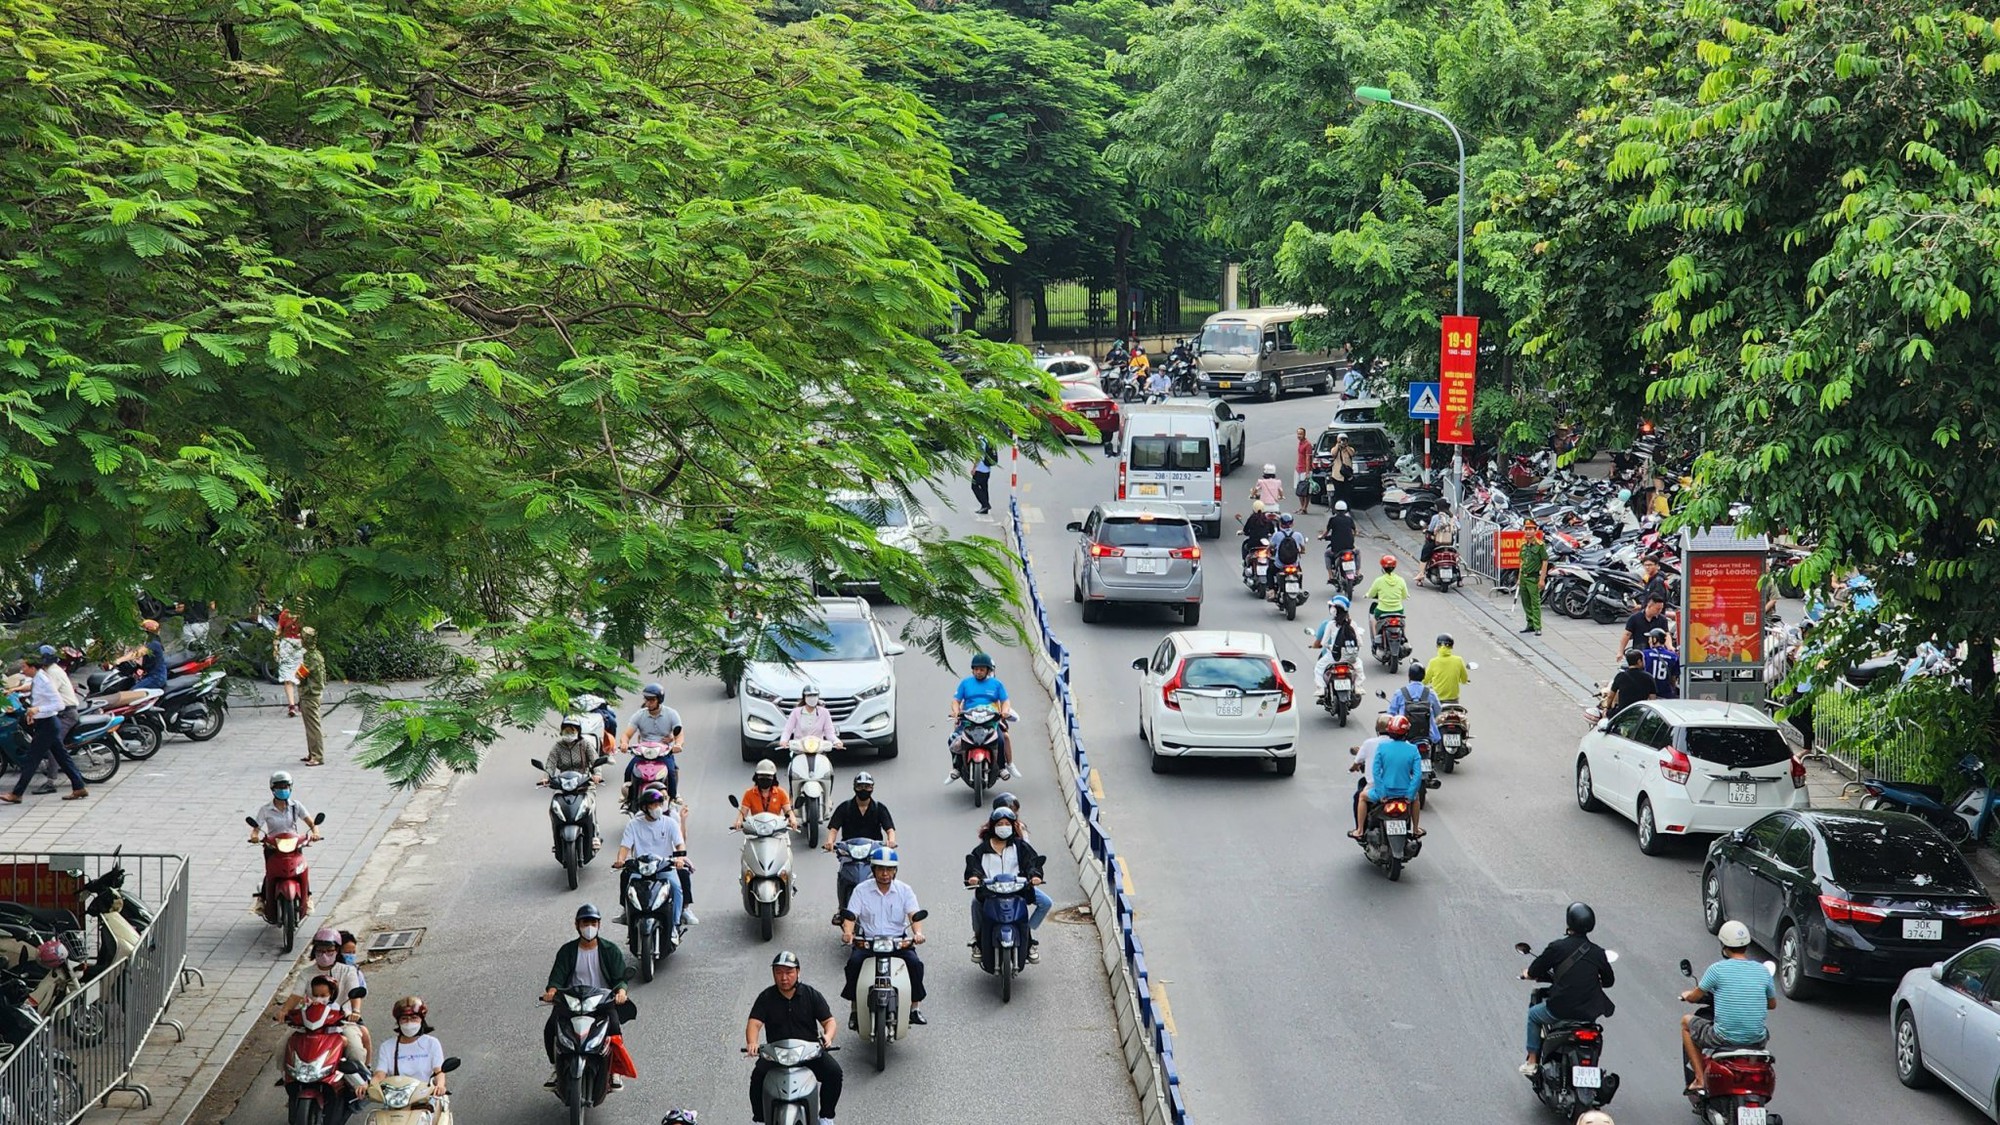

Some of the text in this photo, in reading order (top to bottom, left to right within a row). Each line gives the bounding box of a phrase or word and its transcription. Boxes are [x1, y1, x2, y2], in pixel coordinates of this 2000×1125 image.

[1447, 331, 1472, 348] 19-8
[1726, 568, 1757, 576] Leaders
[1652, 659, 1668, 680] 18
[1735, 784, 1750, 793] 30E
[1914, 921, 1931, 930] 30K
[1907, 930, 1937, 938] 374.71
